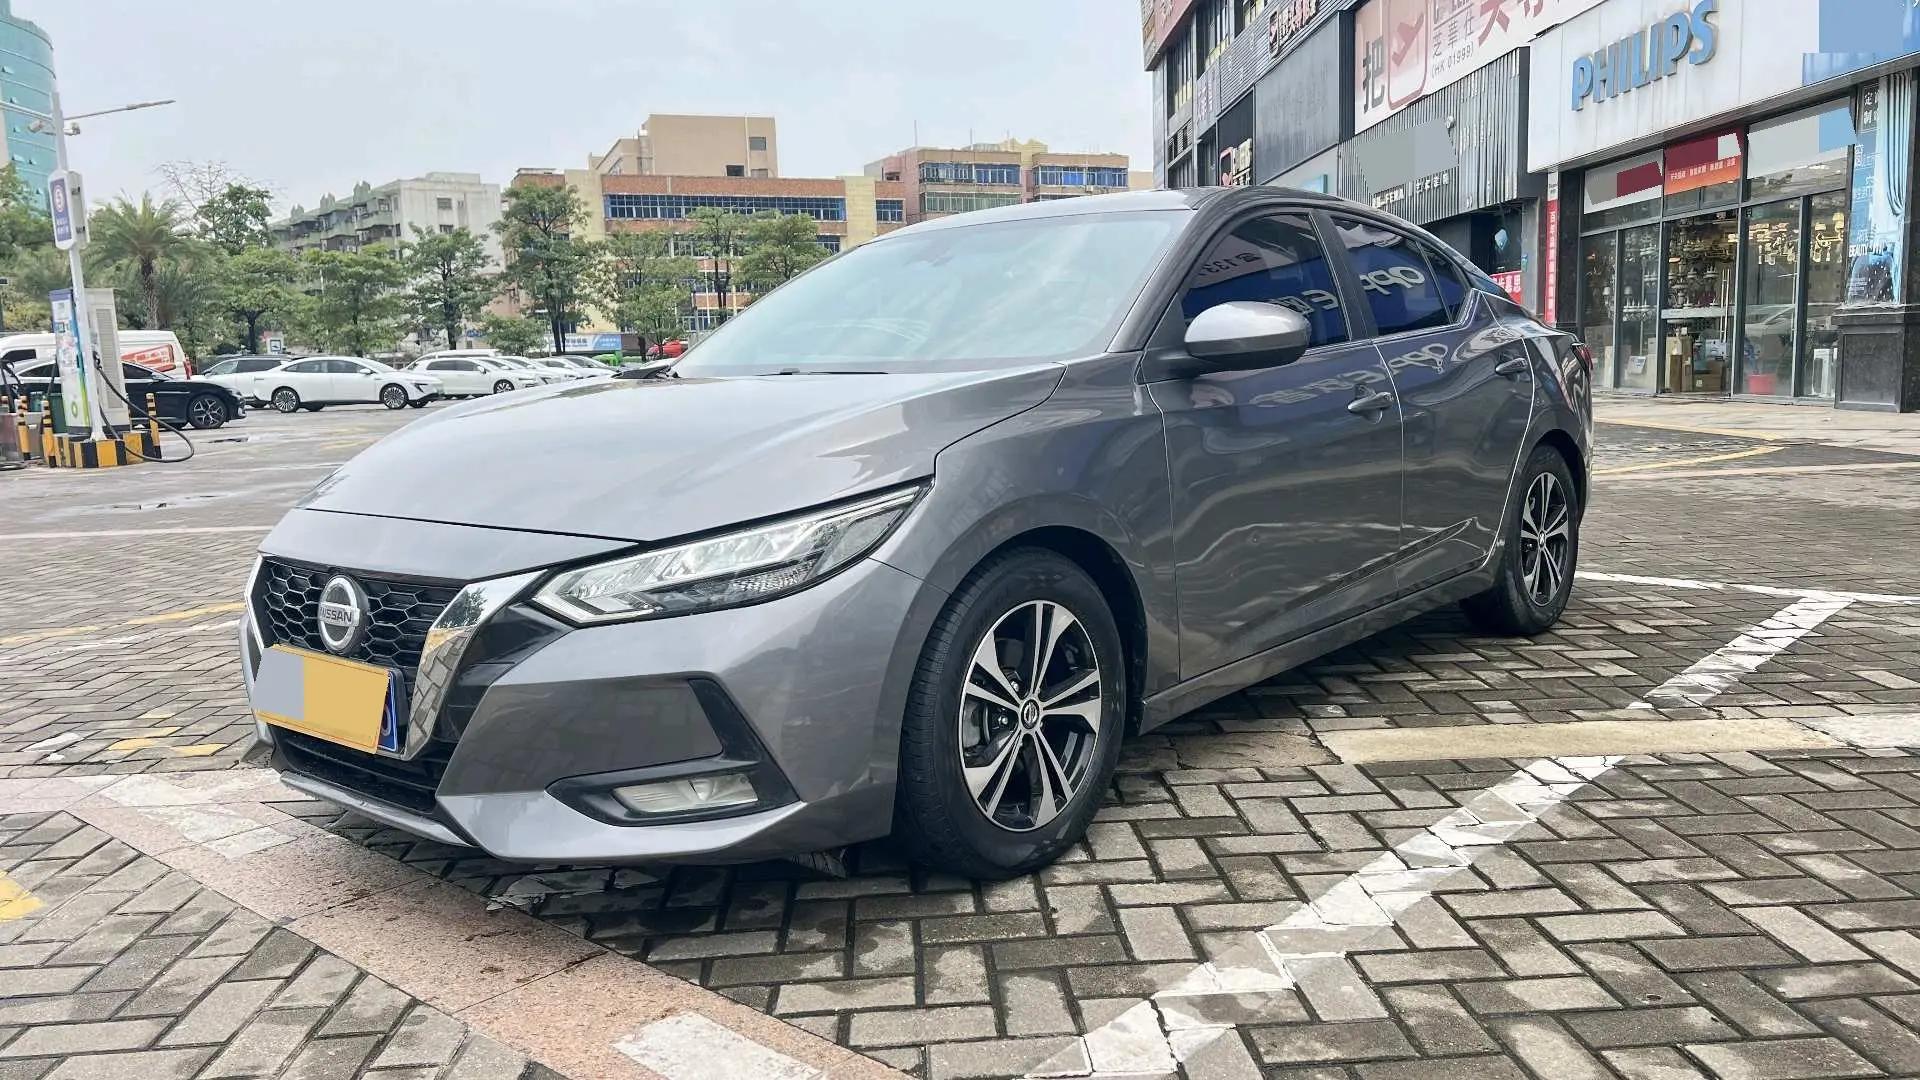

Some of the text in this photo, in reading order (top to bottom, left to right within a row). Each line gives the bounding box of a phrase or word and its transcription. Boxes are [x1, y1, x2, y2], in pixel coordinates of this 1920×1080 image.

[1363, 37, 1385, 114] 把
[1571, 0, 1718, 111] PHILIPS
[320, 606, 352, 622] NISSAN
